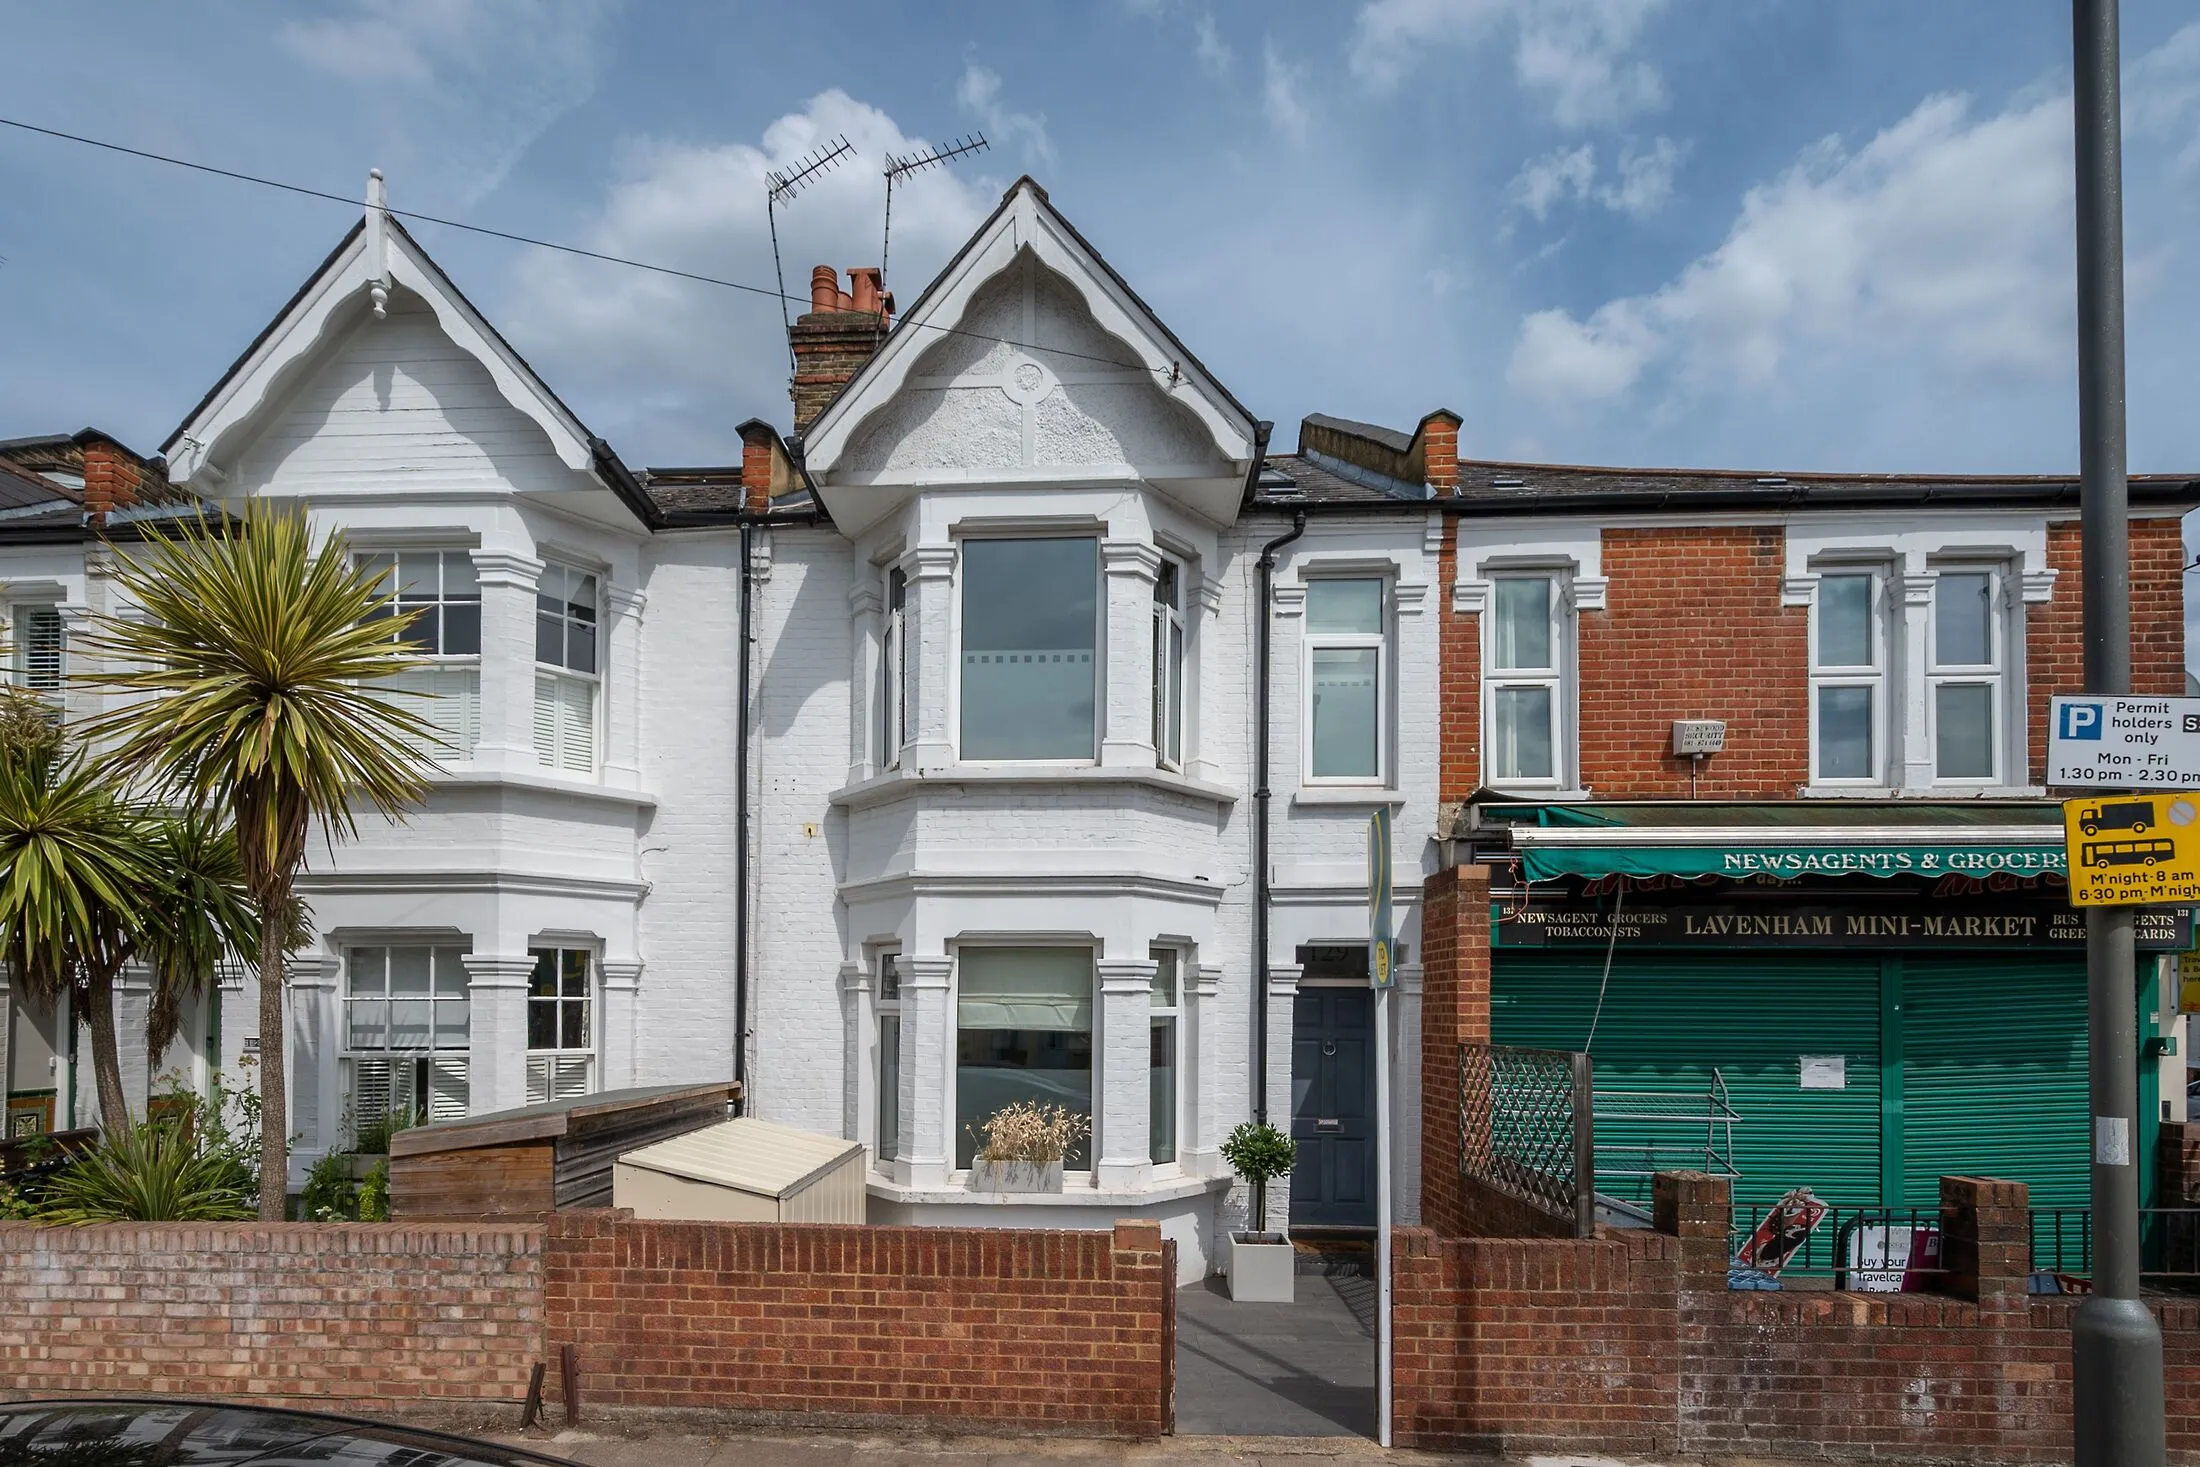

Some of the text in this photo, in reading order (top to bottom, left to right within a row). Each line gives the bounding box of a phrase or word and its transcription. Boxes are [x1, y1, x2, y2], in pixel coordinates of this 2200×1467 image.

[2116, 702, 2169, 714] Permit
[2069, 707, 2096, 737] P
[2112, 717, 2173, 729] holders
[2185, 717, 2200, 731] S
[2125, 732, 2159, 745] only
[2098, 753, 2132, 765] Mon
[2148, 754, 2169, 766] Fri
[2060, 767, 2094, 780] 1.30
[2098, 771, 2122, 782] pm
[2139, 769, 2178, 782] 2.30
[1724, 853, 1913, 869] NEWSAGENTS
[1921, 852, 1940, 869] &
[2171, 871, 2194, 881] am
[1517, 913, 1668, 925] NEWSAGENT GROCERS
[2177, 909, 2189, 917] 131
[1684, 915, 2037, 936] LAVENHAM MINI-MARKET
[2053, 914, 2079, 925] BUS
[2049, 928, 2087, 939] GREE
[1857, 1271, 1905, 1282] Travelca
